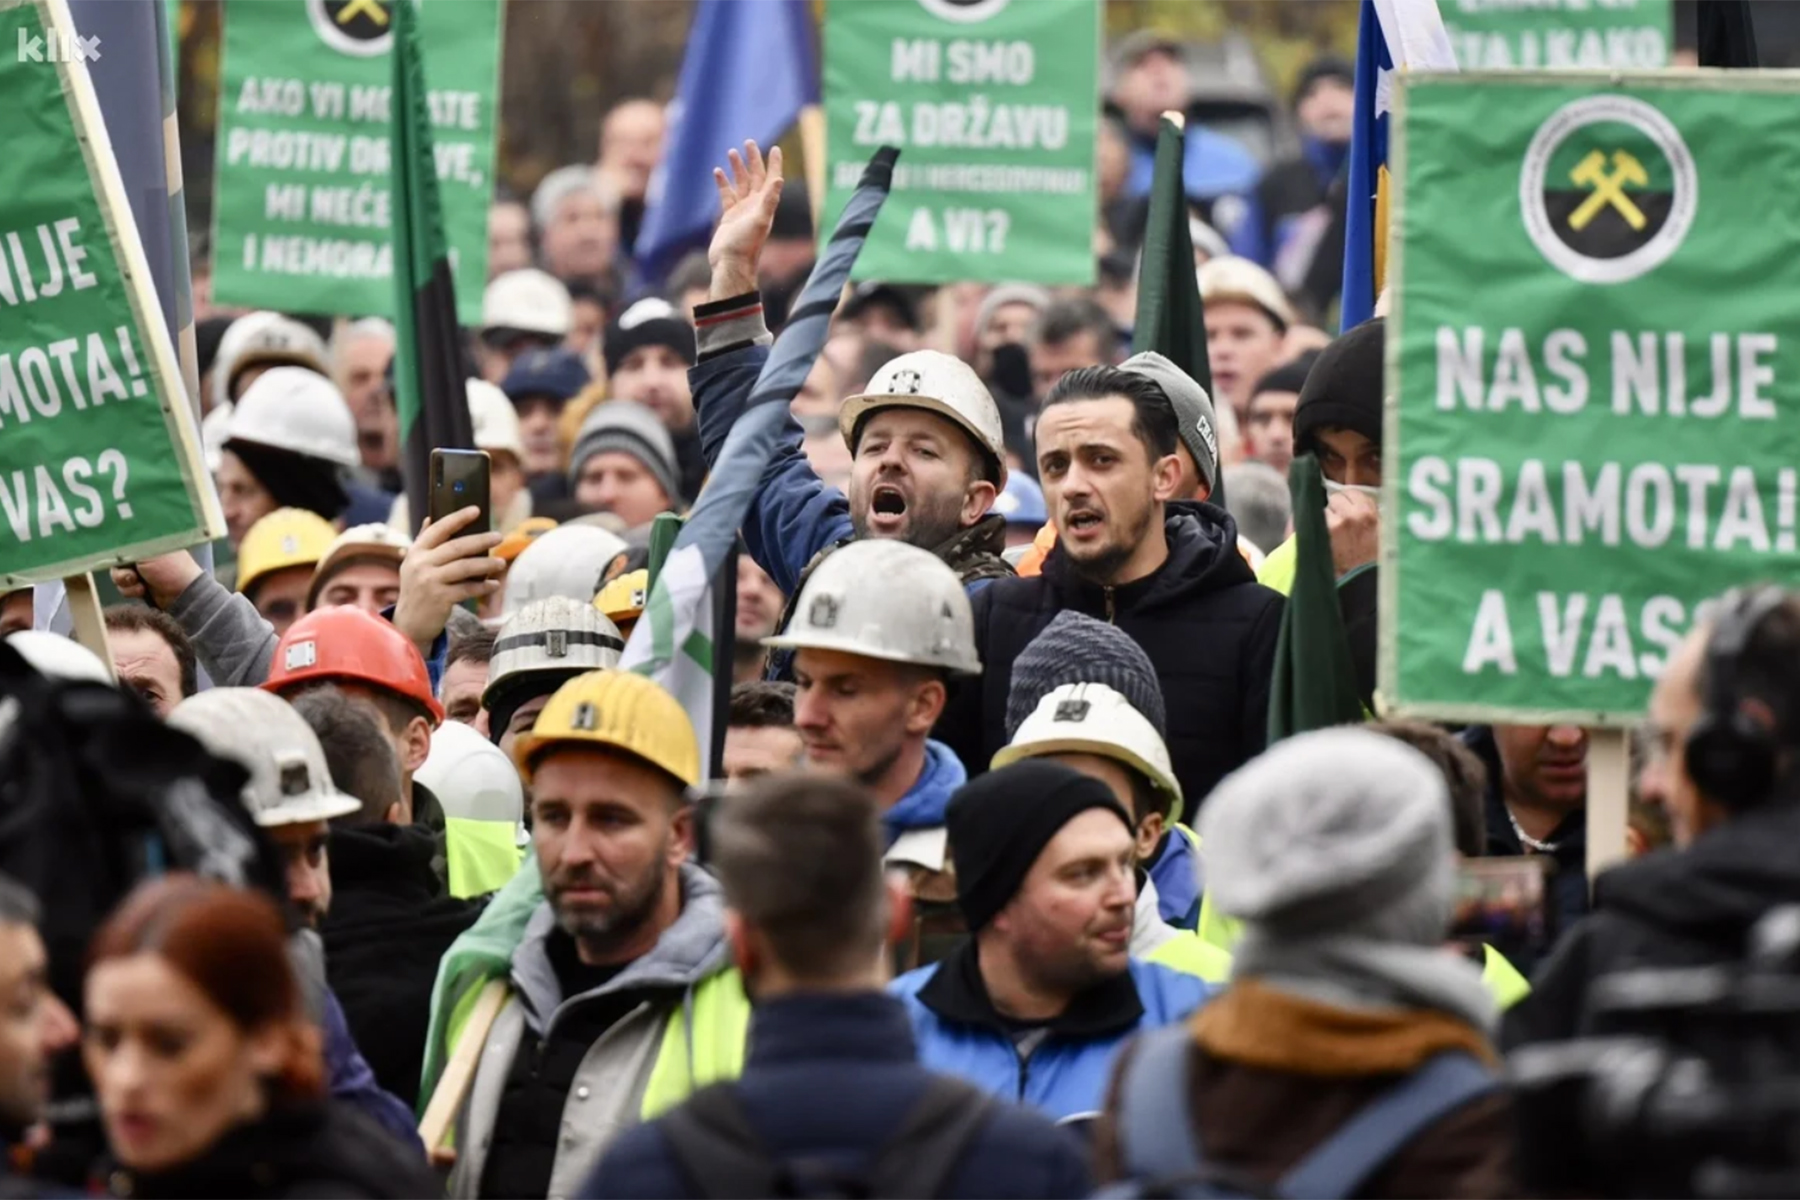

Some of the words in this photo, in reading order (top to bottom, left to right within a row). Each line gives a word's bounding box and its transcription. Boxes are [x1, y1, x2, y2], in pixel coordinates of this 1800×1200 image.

[891, 38, 940, 82] MI
[947, 40, 1034, 85] SMO
[1520, 28, 1538, 69] I
[1546, 26, 1666, 69] KAKO
[237, 76, 304, 116] AKO
[310, 81, 344, 121] VI
[853, 100, 905, 145] ZA
[912, 94, 1068, 150] DRŽAVU
[227, 127, 346, 172] PROTIV
[351, 135, 483, 189] DRVE,
[265, 183, 304, 221] MI
[311, 180, 391, 228] NEĆE
[906, 207, 937, 251] A
[944, 208, 1010, 253] VI?
[243, 233, 257, 272] I
[1435, 326, 1589, 414] NAS
[1611, 330, 1777, 419] NIJE
[0, 448, 134, 542] VAS?
[1407, 456, 1797, 554] SRAMOTA!
[1462, 589, 1517, 674] A
